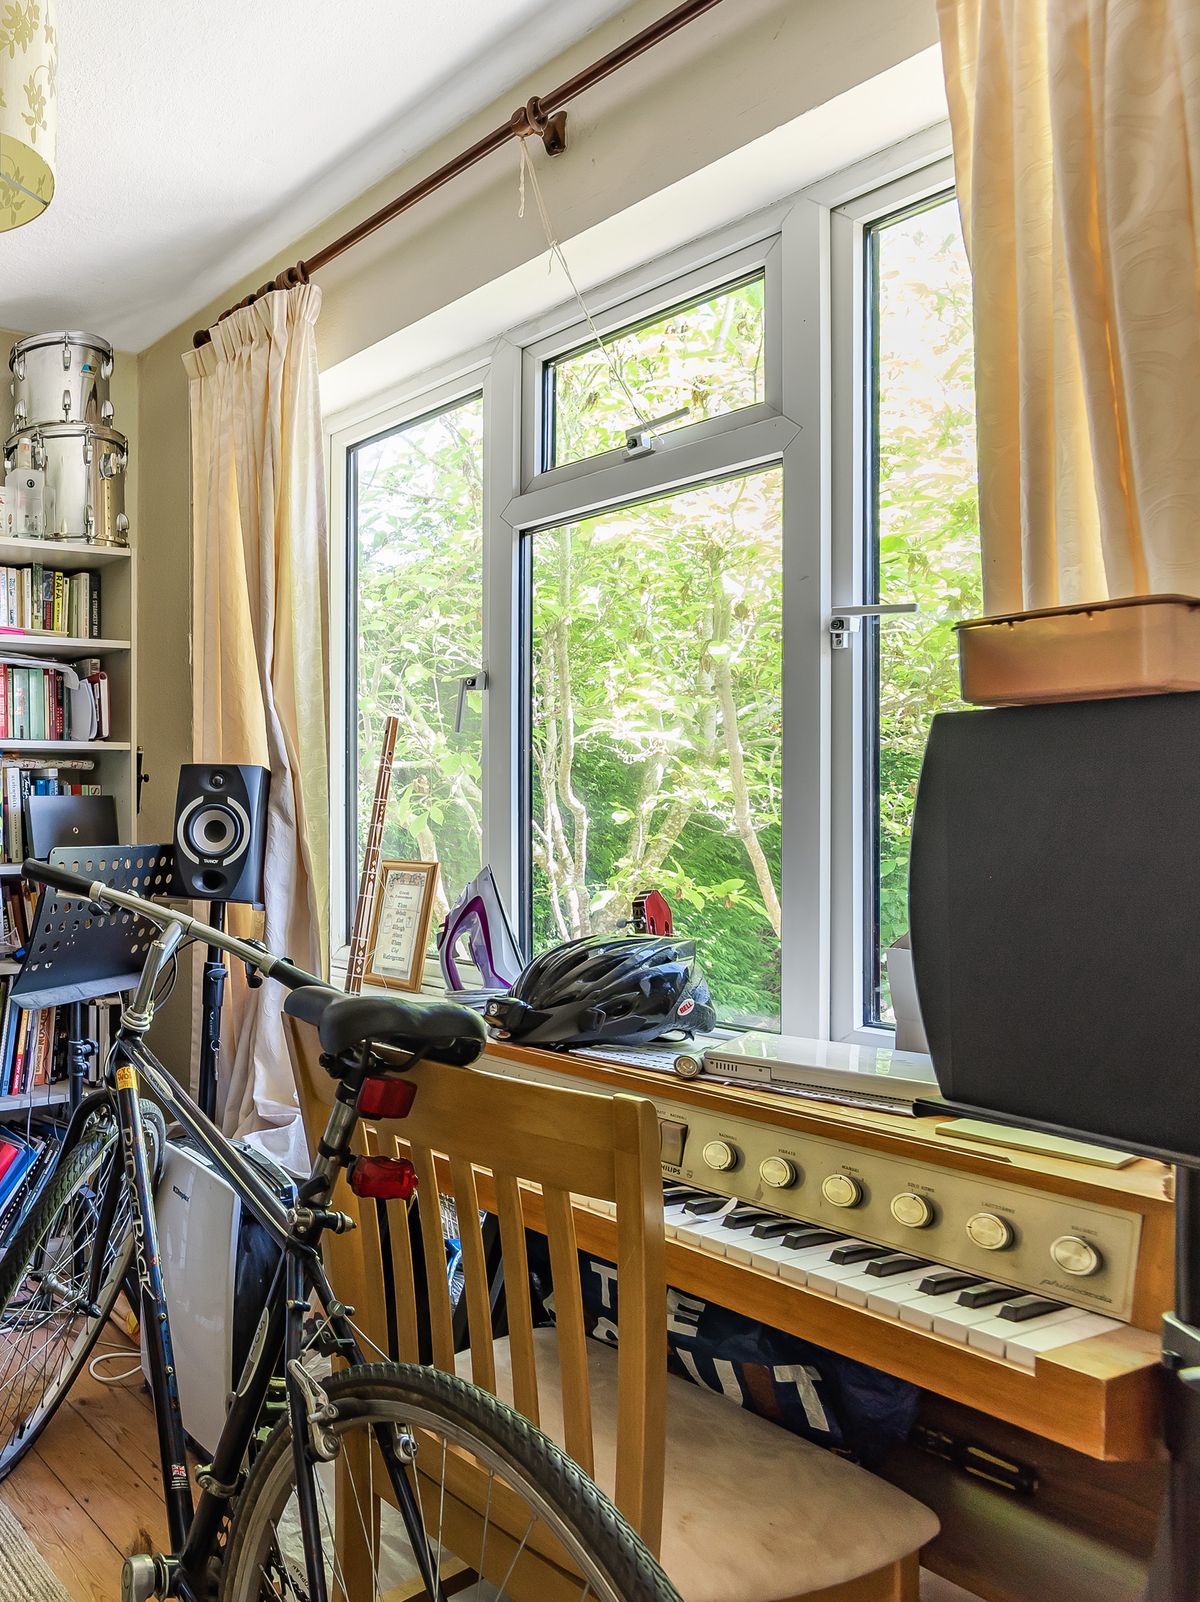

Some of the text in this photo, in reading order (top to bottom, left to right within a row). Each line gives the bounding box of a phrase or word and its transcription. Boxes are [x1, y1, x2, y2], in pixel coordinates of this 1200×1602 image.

[680, 1001, 693, 1013] BELL
[778, 1148, 796, 1156] VIBRATO
[661, 1164, 680, 1175] HILIPS
[122, 1126, 156, 1300] RIDGEBACK
[292, 1565, 310, 1589] OPMAN
